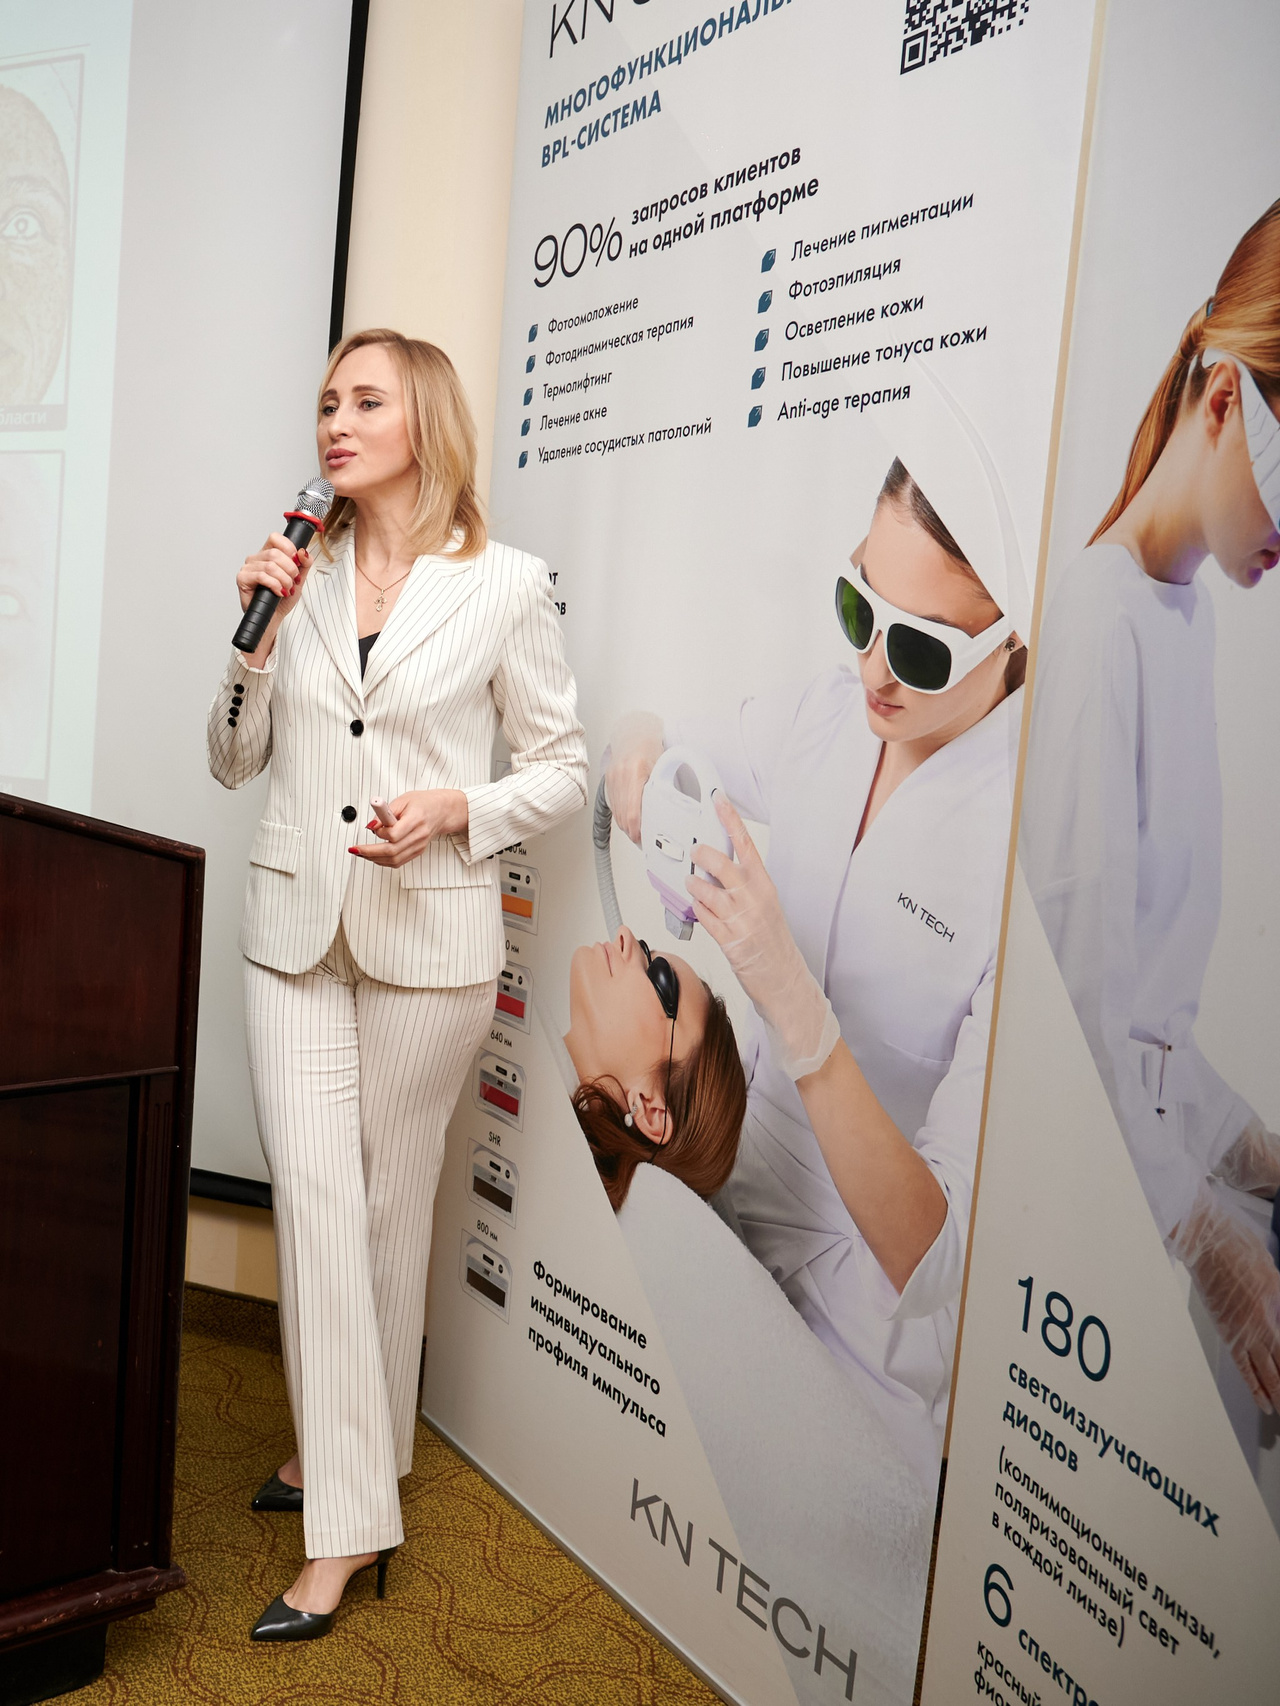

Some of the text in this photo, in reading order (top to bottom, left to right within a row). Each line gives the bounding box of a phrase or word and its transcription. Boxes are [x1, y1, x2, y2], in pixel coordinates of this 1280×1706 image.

[541, 90, 661, 168] BPL-СИСТЕМА
[629, 177, 819, 258] на одной платформе
[631, 147, 801, 225] запросов клиентов
[534, 217, 623, 288] 90%
[791, 192, 974, 261] Лечение пигментации
[788, 258, 901, 300] Фотоэпиляция
[545, 315, 694, 366] Фотодинамическая терапия
[548, 297, 639, 333] Фотоомоложение
[785, 295, 924, 341] Осветление кожи
[543, 371, 613, 401] Термолифтинг
[781, 325, 988, 381] Повышение тонуса кожи
[540, 406, 607, 431] Лечение акне
[777, 385, 911, 421] Anti-age терапия
[538, 417, 712, 464] Удаление сосудистых патологий
[897, 892, 955, 943] KN TECH
[490, 1029, 503, 1044] 640
[488, 1131, 501, 1147] SHR
[476, 1219, 489, 1236] 800
[533, 1260, 647, 1349] Формирование
[1017, 1275, 1111, 1382] 180
[530, 1296, 660, 1395] индивидуального
[528, 1327, 666, 1437] профиля импульса
[1002, 1400, 1078, 1472] диодов
[1008, 1362, 1219, 1538] светоизлучающих
[991, 1511, 1125, 1648] в каждой линзе)
[995, 1483, 1180, 1655] поляризованный свет
[998, 1445, 1220, 1659] (коллимационные линзы,
[630, 1477, 858, 1702] KN TECH
[983, 1563, 1014, 1628] 6
